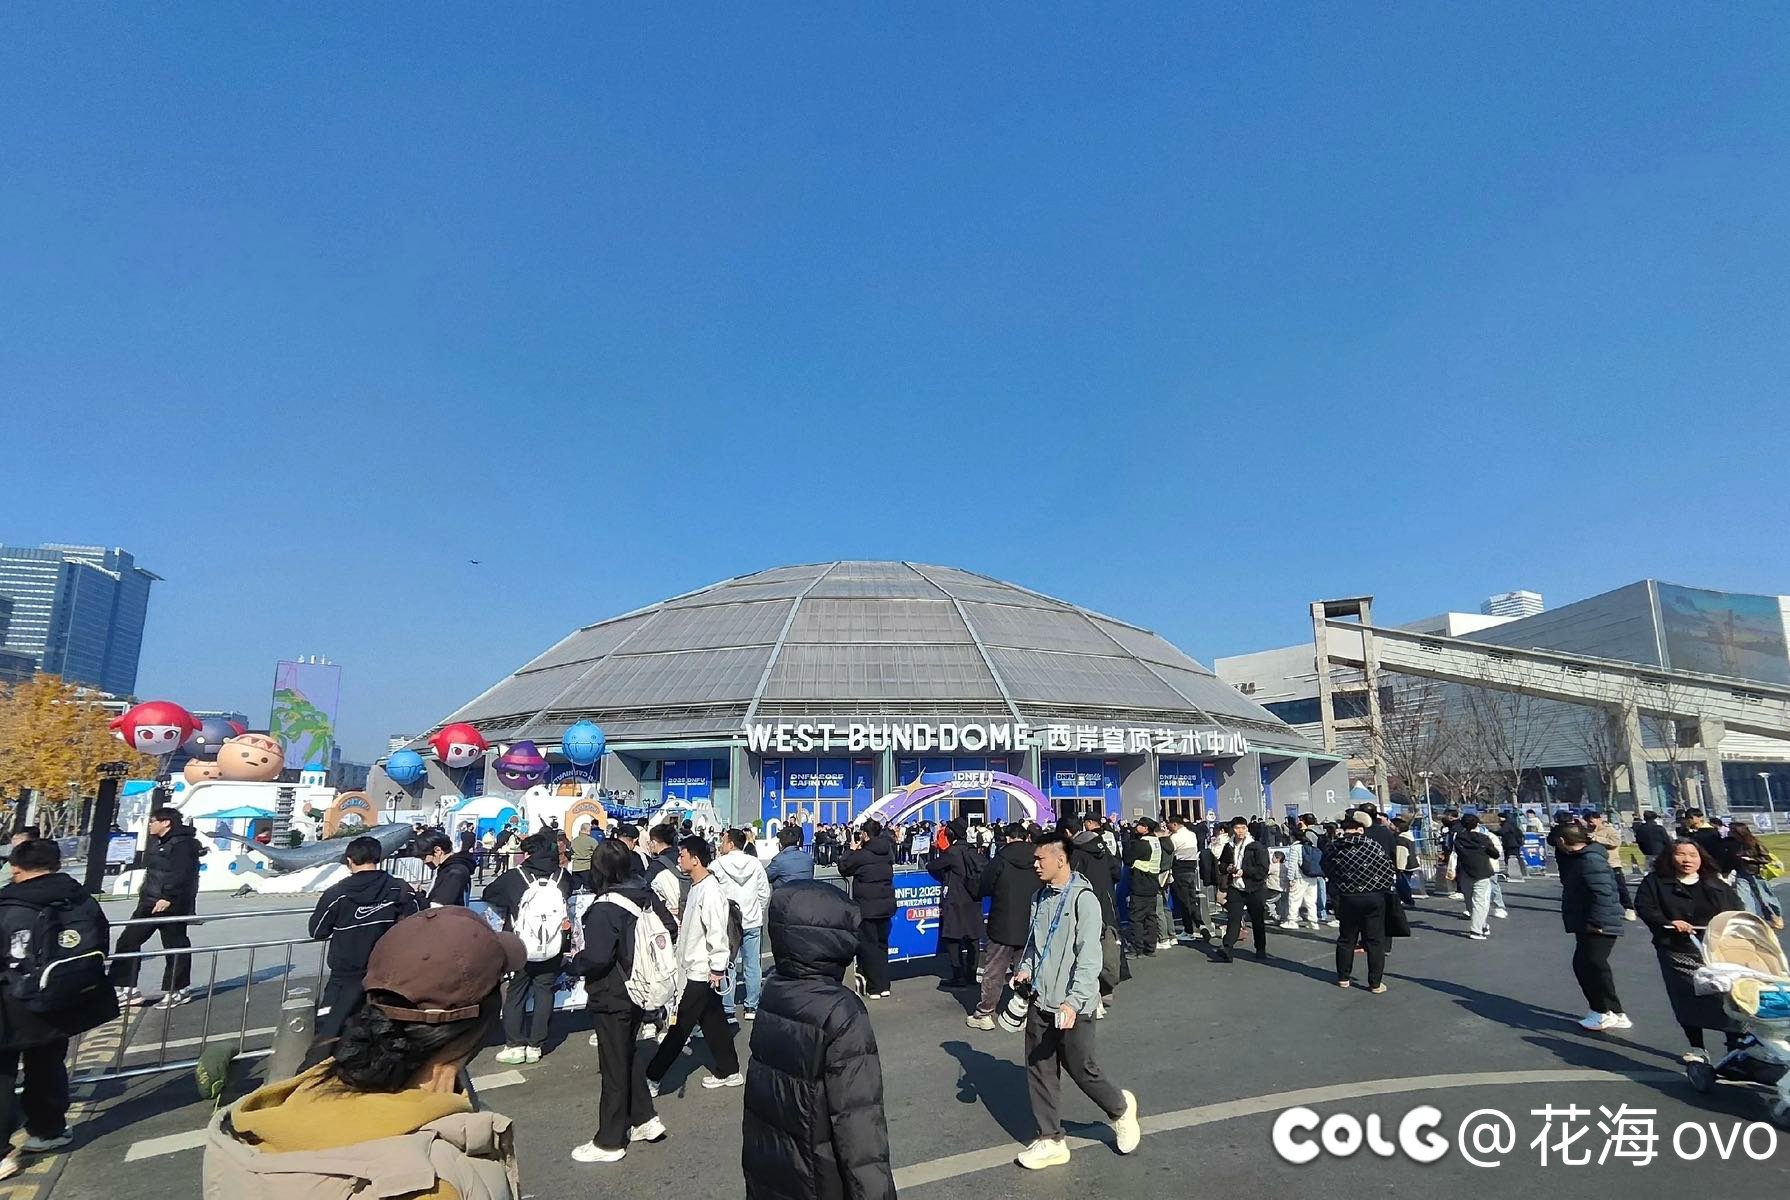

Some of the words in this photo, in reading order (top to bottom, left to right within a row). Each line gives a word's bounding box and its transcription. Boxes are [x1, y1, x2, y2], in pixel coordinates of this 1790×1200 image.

[746, 723, 835, 752] WEST
[849, 723, 931, 751] BUND
[939, 723, 1031, 751] DOME
[1048, 724, 1249, 756] 西岸穹顶艺术中心
[1326, 790, 1336, 803] R
[919, 886, 941, 898] 2025
